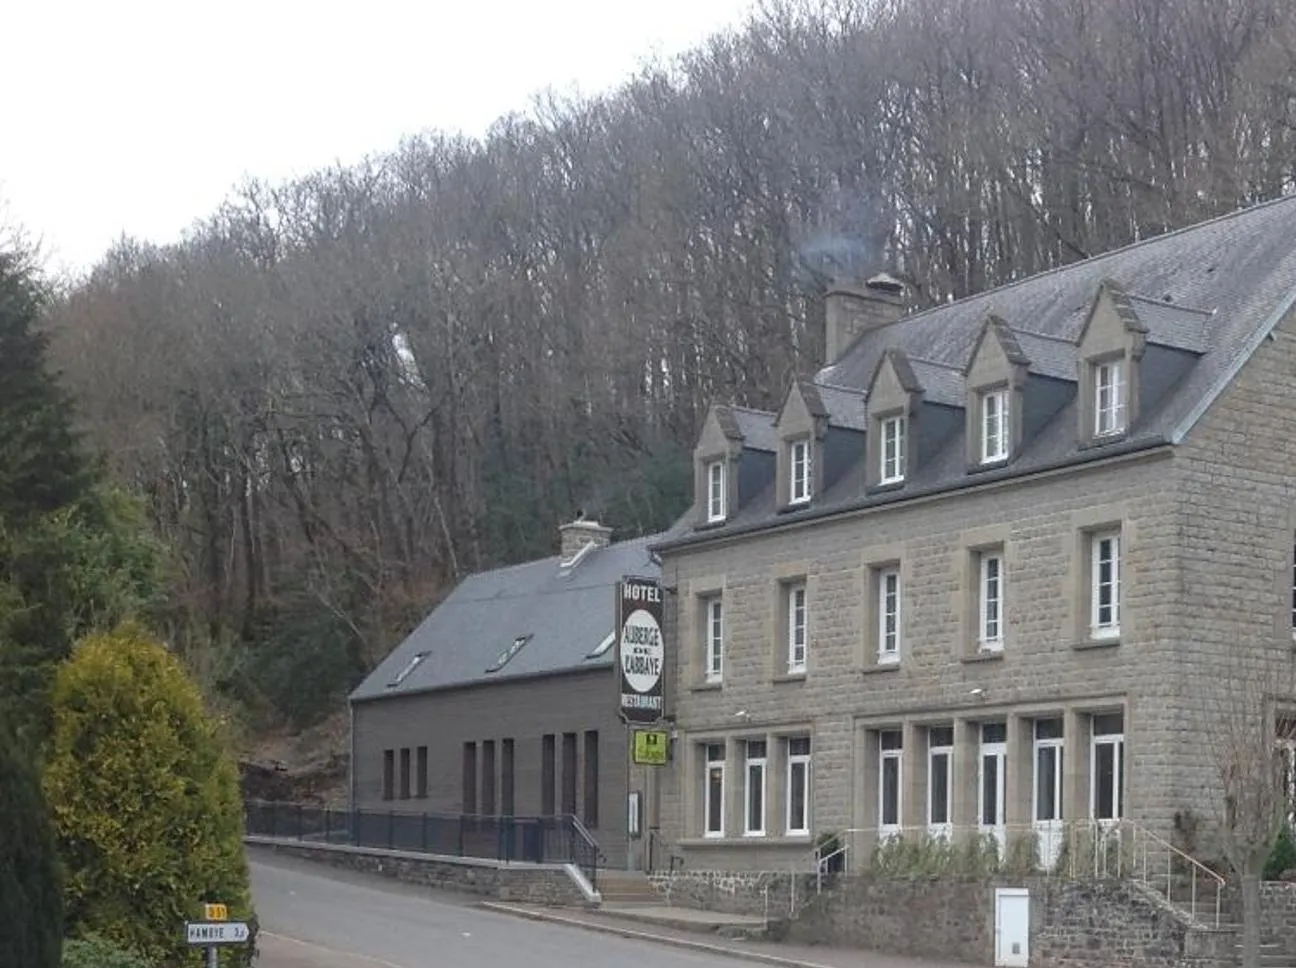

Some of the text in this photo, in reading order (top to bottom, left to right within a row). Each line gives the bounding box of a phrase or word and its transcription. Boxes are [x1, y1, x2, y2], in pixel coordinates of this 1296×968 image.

[624, 584, 660, 602] HOTEL
[624, 626, 659, 646] AUBERGE
[190, 928, 224, 938] HAMBYE
